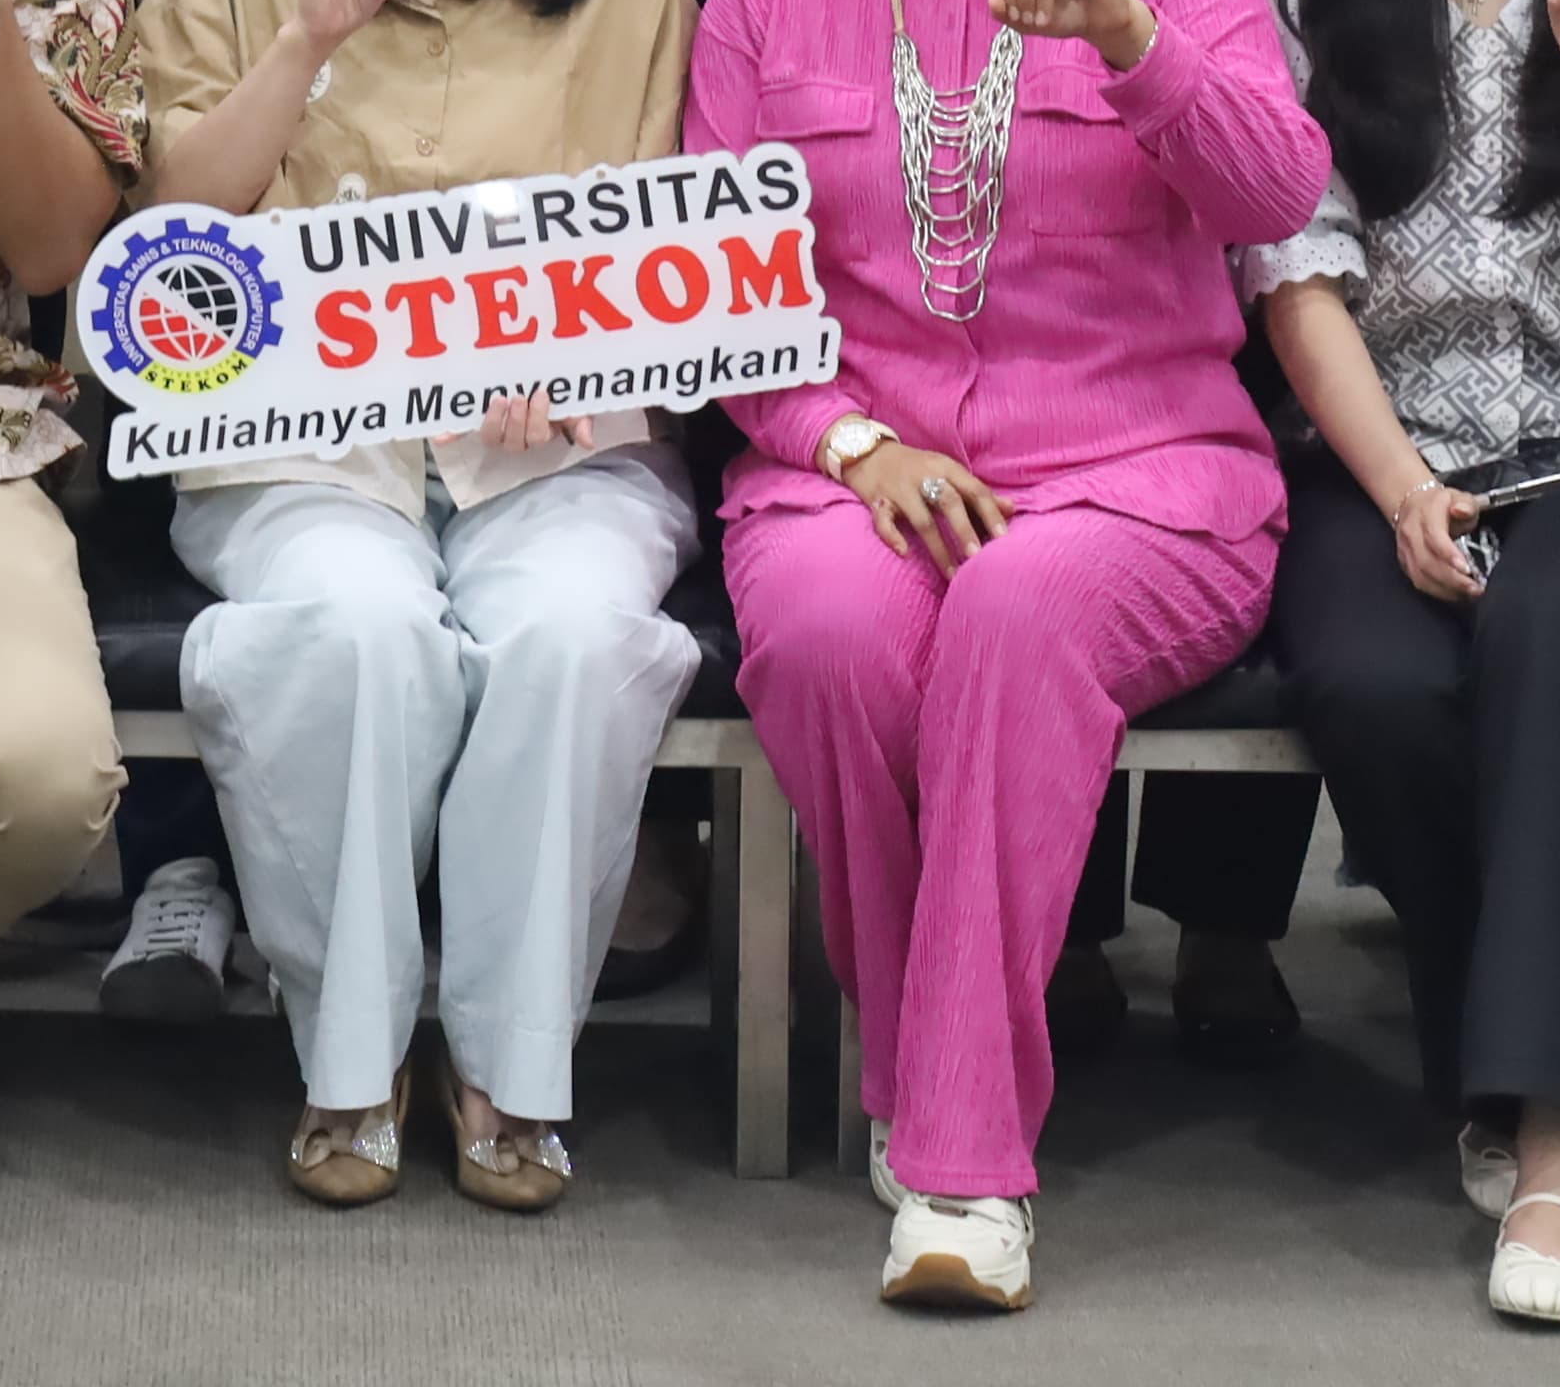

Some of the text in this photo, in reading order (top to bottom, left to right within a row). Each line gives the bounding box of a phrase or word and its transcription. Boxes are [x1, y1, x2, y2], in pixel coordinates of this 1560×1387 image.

[299, 159, 800, 274] UNIVERSITAS
[113, 280, 145, 367] UNIVERSITAS
[129, 248, 159, 280] SAINS
[172, 237, 249, 277] TEKNOLOGI
[242, 272, 265, 351] KOMPUTER
[314, 228, 813, 369] STEKOM
[145, 357, 249, 393] STEKOM
[126, 402, 388, 464] Kuliahnya
